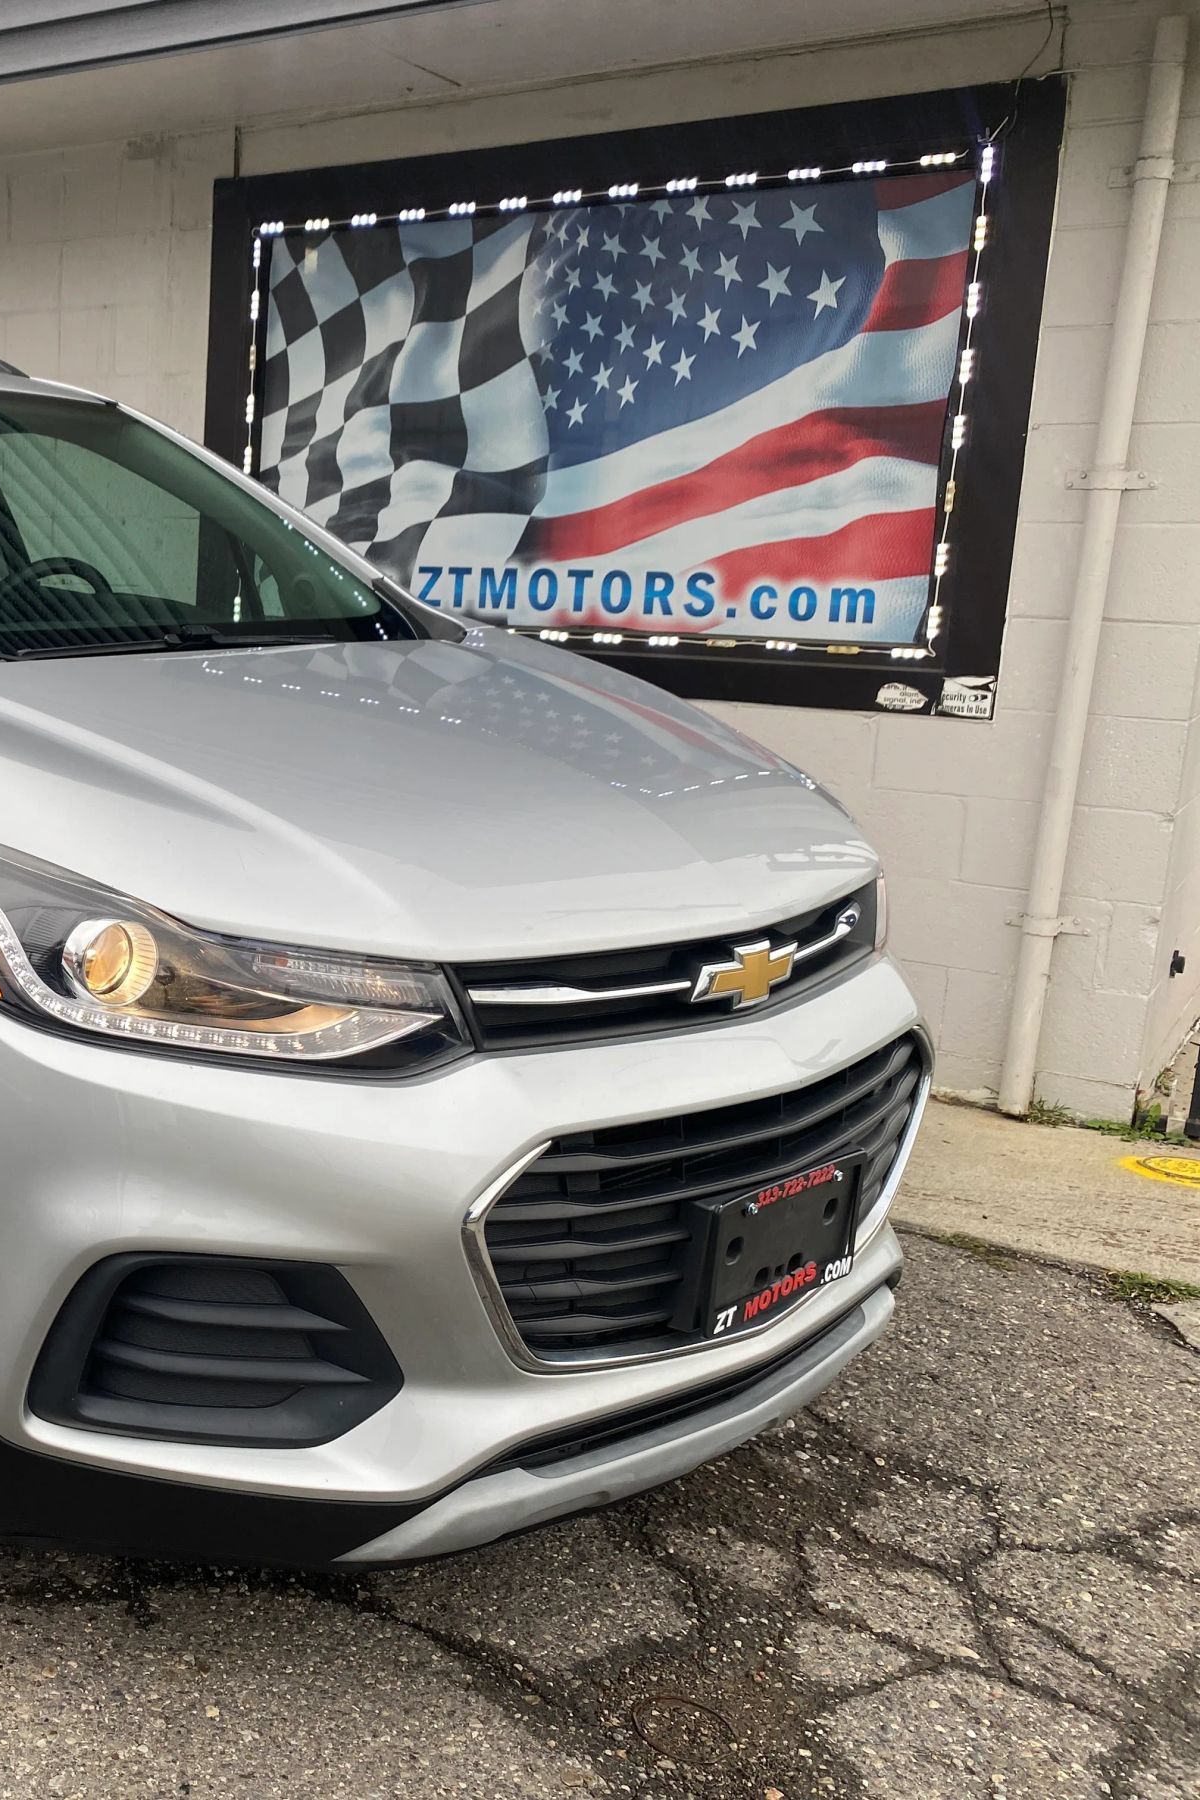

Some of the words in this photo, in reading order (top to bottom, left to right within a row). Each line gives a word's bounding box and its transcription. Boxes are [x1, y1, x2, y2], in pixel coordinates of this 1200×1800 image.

[417, 566, 877, 624] ZTMOTORS.com
[942, 692, 967, 703] ecurity
[974, 705, 988, 715] Use
[713, 1305, 738, 1335] ZT
[743, 1260, 817, 1322] MOTORS
